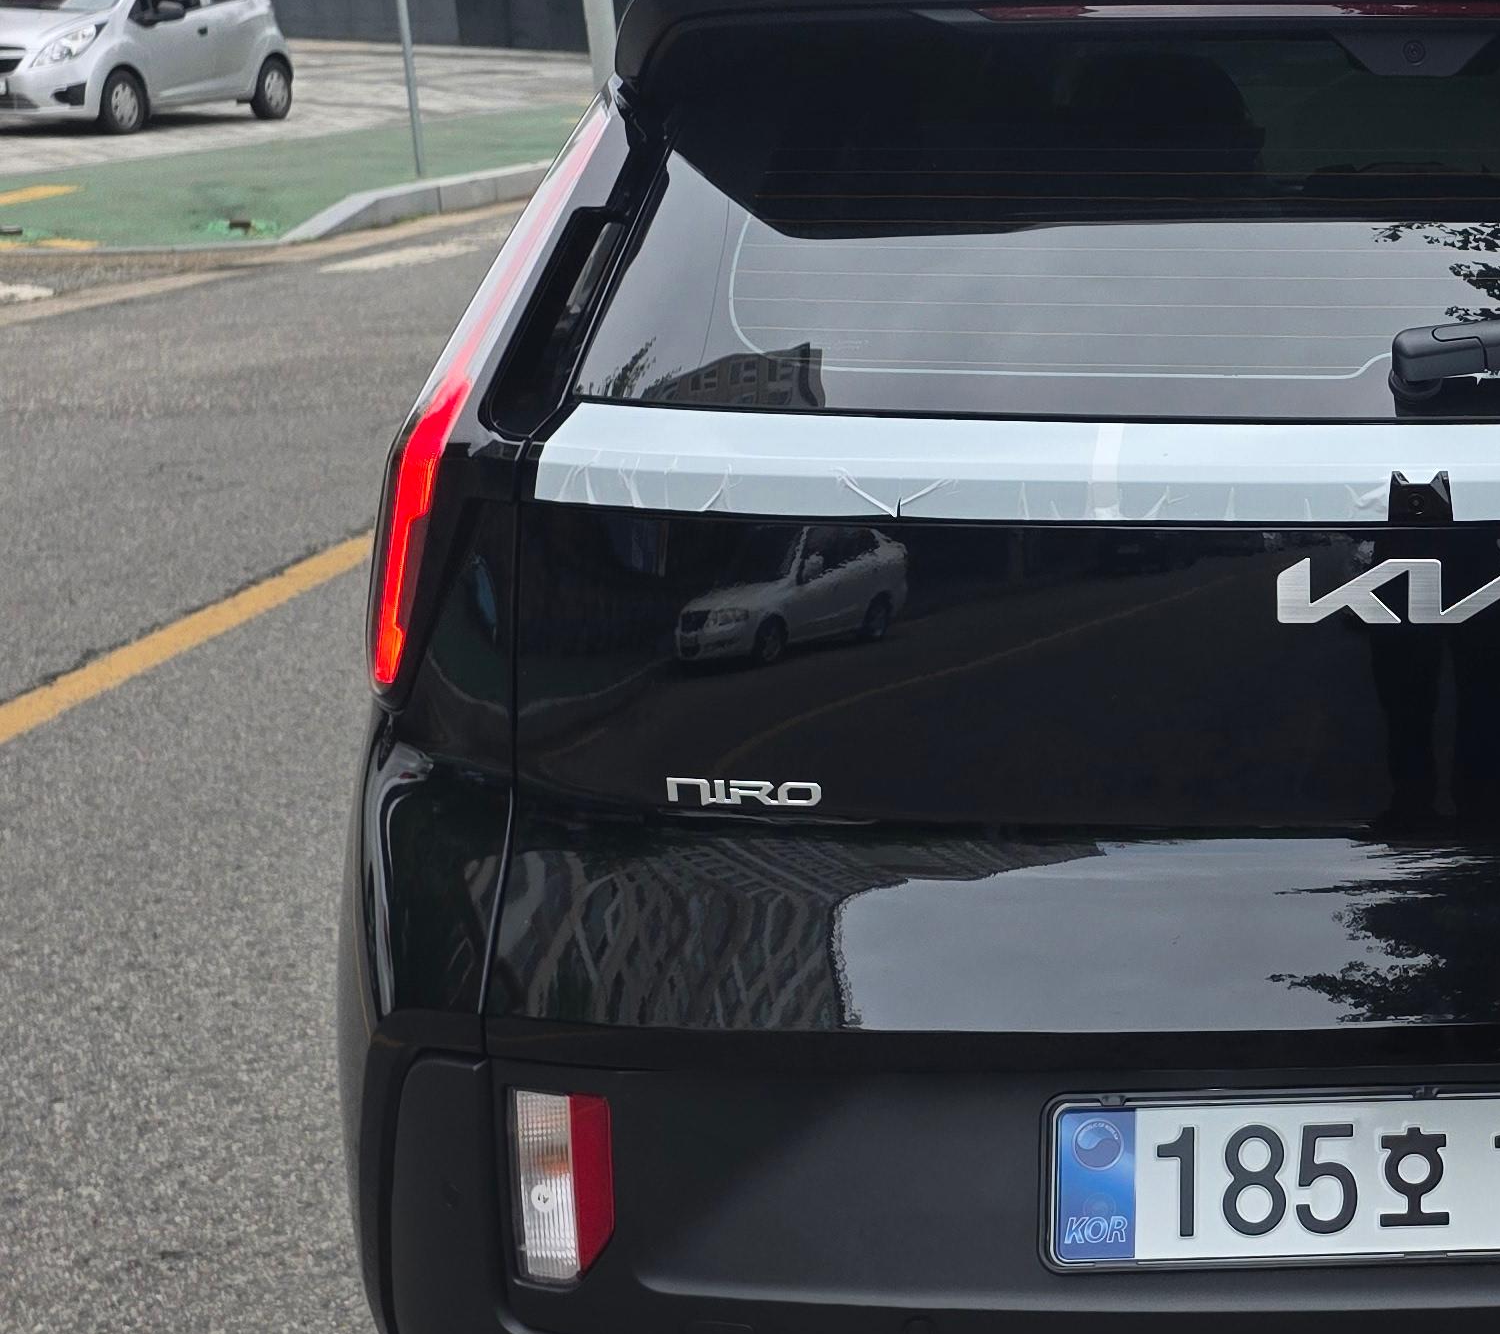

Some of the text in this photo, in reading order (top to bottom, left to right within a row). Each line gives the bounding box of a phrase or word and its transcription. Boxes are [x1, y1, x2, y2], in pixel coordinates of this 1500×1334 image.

[666, 777, 821, 806] NIRO
[1156, 1123, 1450, 1237] 185호
[1064, 1216, 1128, 1244] KOR
